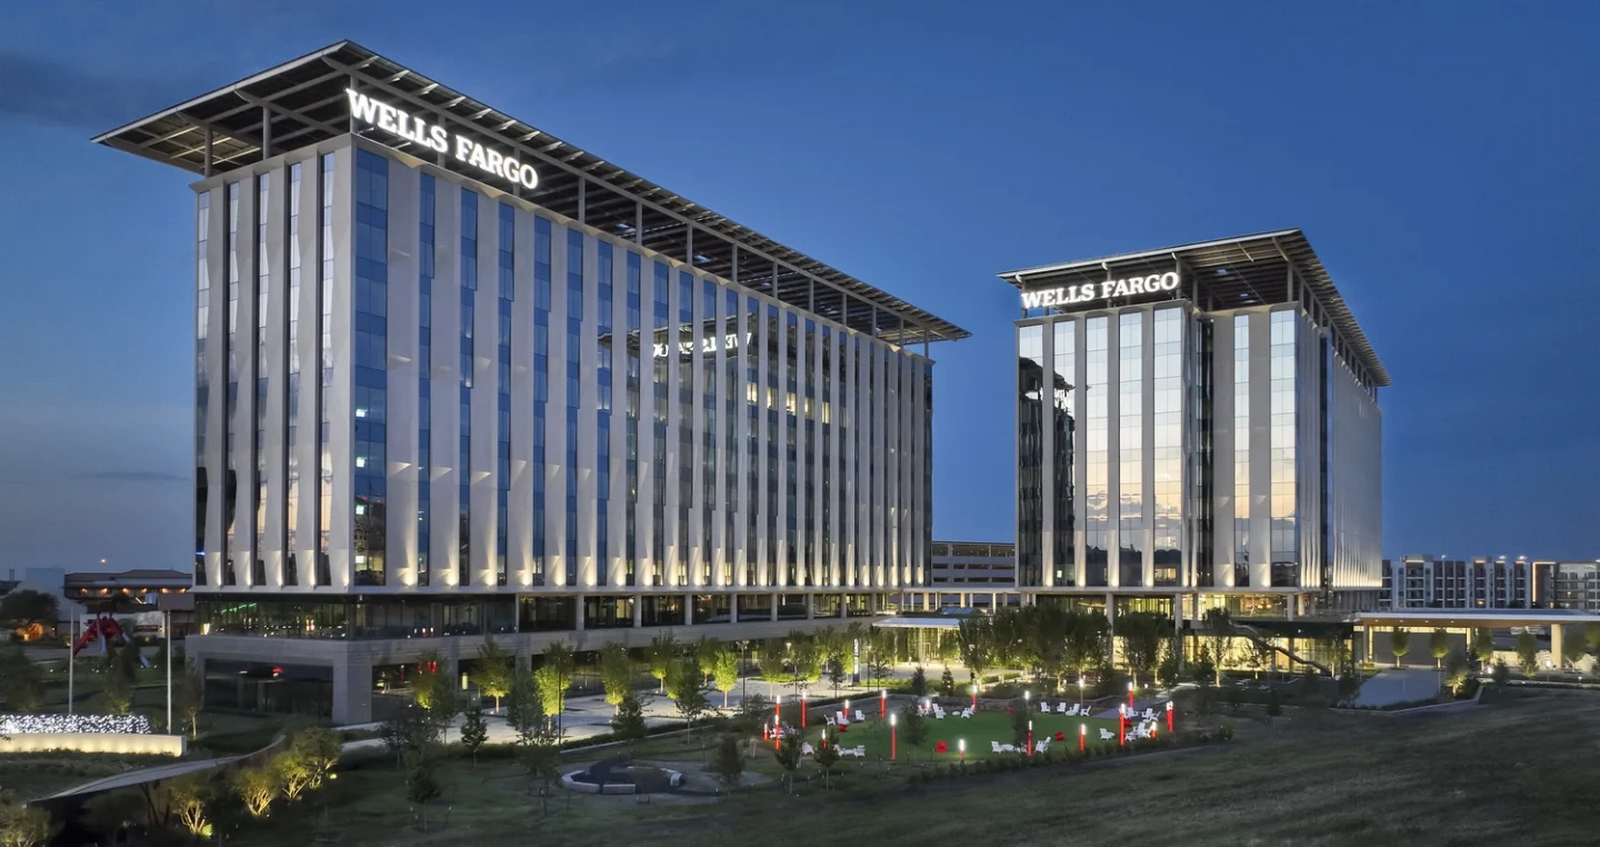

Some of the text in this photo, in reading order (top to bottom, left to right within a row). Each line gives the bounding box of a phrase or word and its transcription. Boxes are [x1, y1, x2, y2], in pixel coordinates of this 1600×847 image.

[346, 88, 539, 190] WELLS FARGO
[1021, 272, 1179, 309] WELLS FARGO
